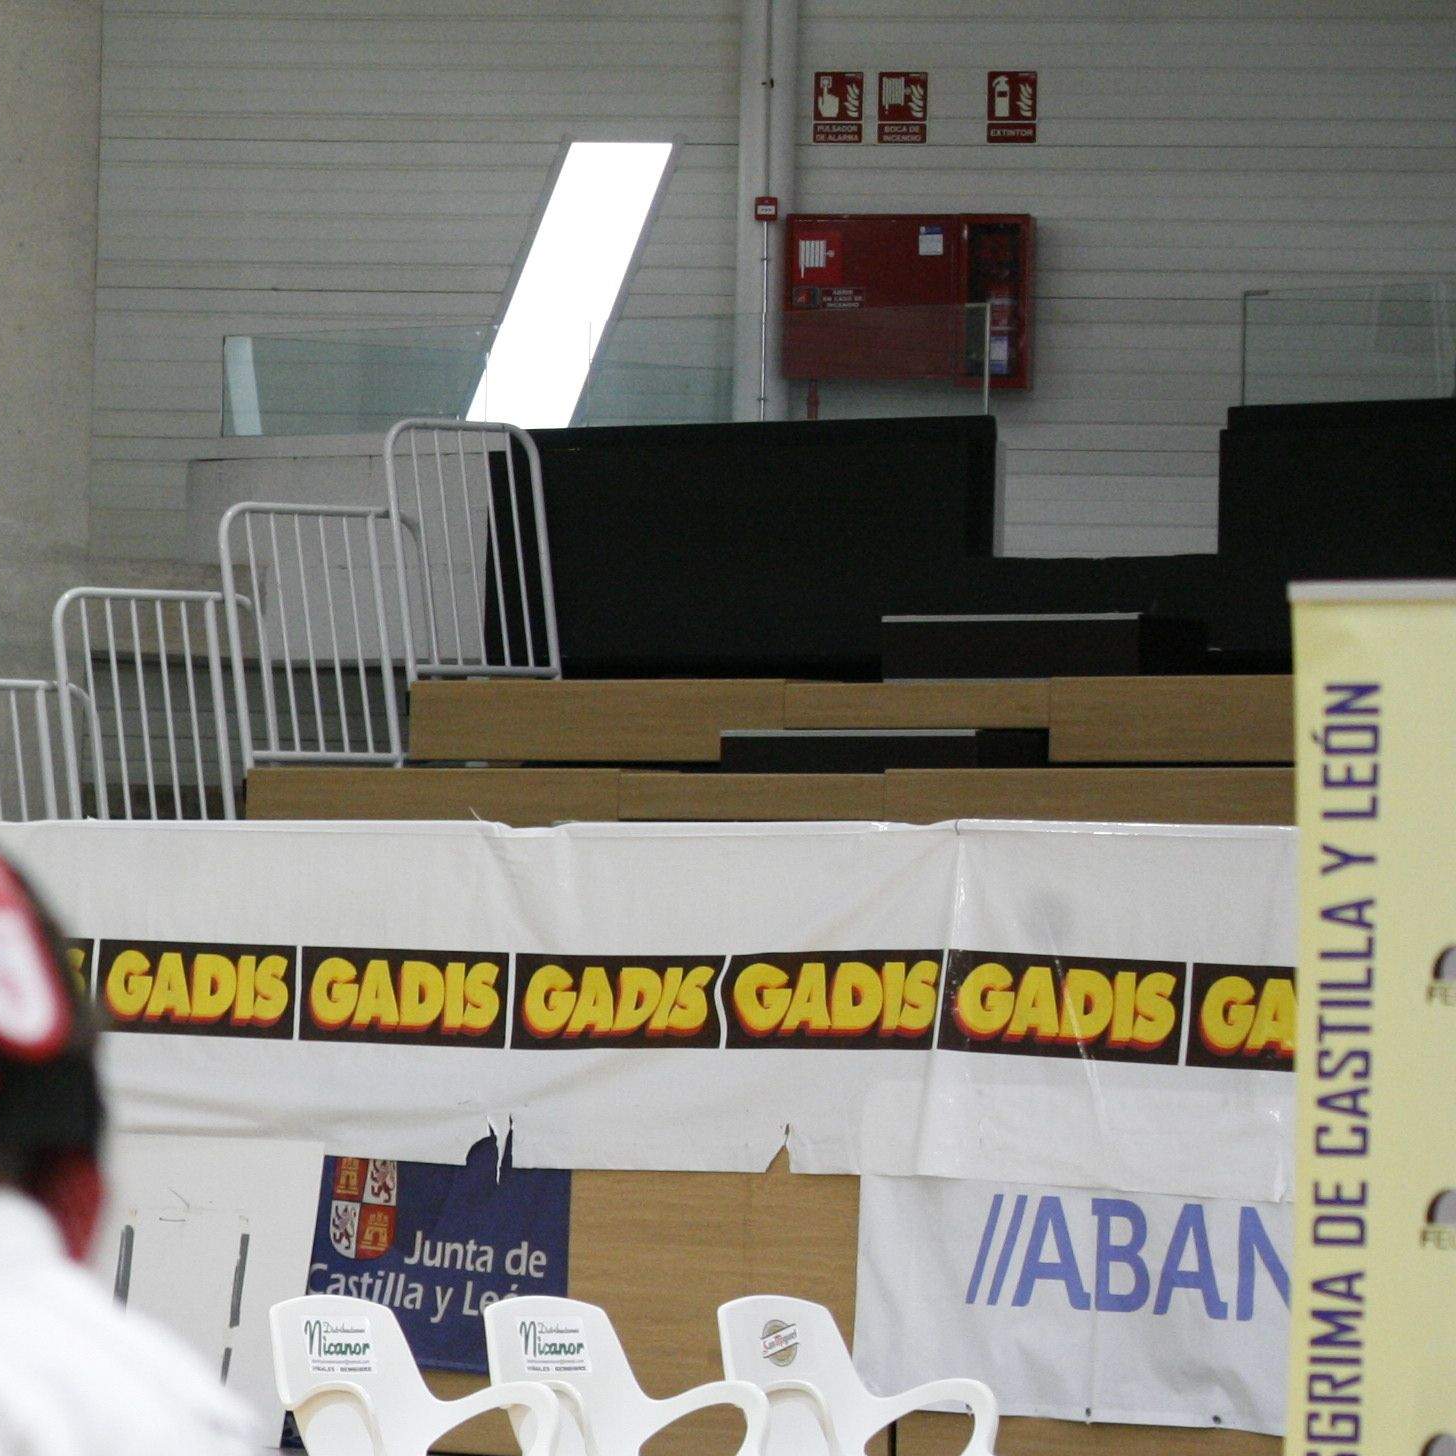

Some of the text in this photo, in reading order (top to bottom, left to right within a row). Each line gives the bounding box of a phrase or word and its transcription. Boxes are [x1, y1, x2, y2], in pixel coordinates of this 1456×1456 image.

[989, 128, 1034, 138] EXTINTOR
[1310, 682, 1383, 821] LEÓN
[1321, 844, 1378, 873] Y
[104, 948, 290, 1029] GADIS
[308, 956, 503, 1037] GADIS
[522, 963, 715, 1041] GADIS
[732, 959, 940, 1042] GADIS
[953, 966, 1178, 1049] GADIS
[1315, 899, 1376, 1158] CASTILLA
[1313, 1183, 1369, 1247] DE
[403, 1229, 548, 1279] Junta de
[307, 1262, 425, 1311] Castilla
[429, 1284, 455, 1324] y
[303, 1319, 370, 1358] Nicanor
[519, 1320, 585, 1358] Nicanor
